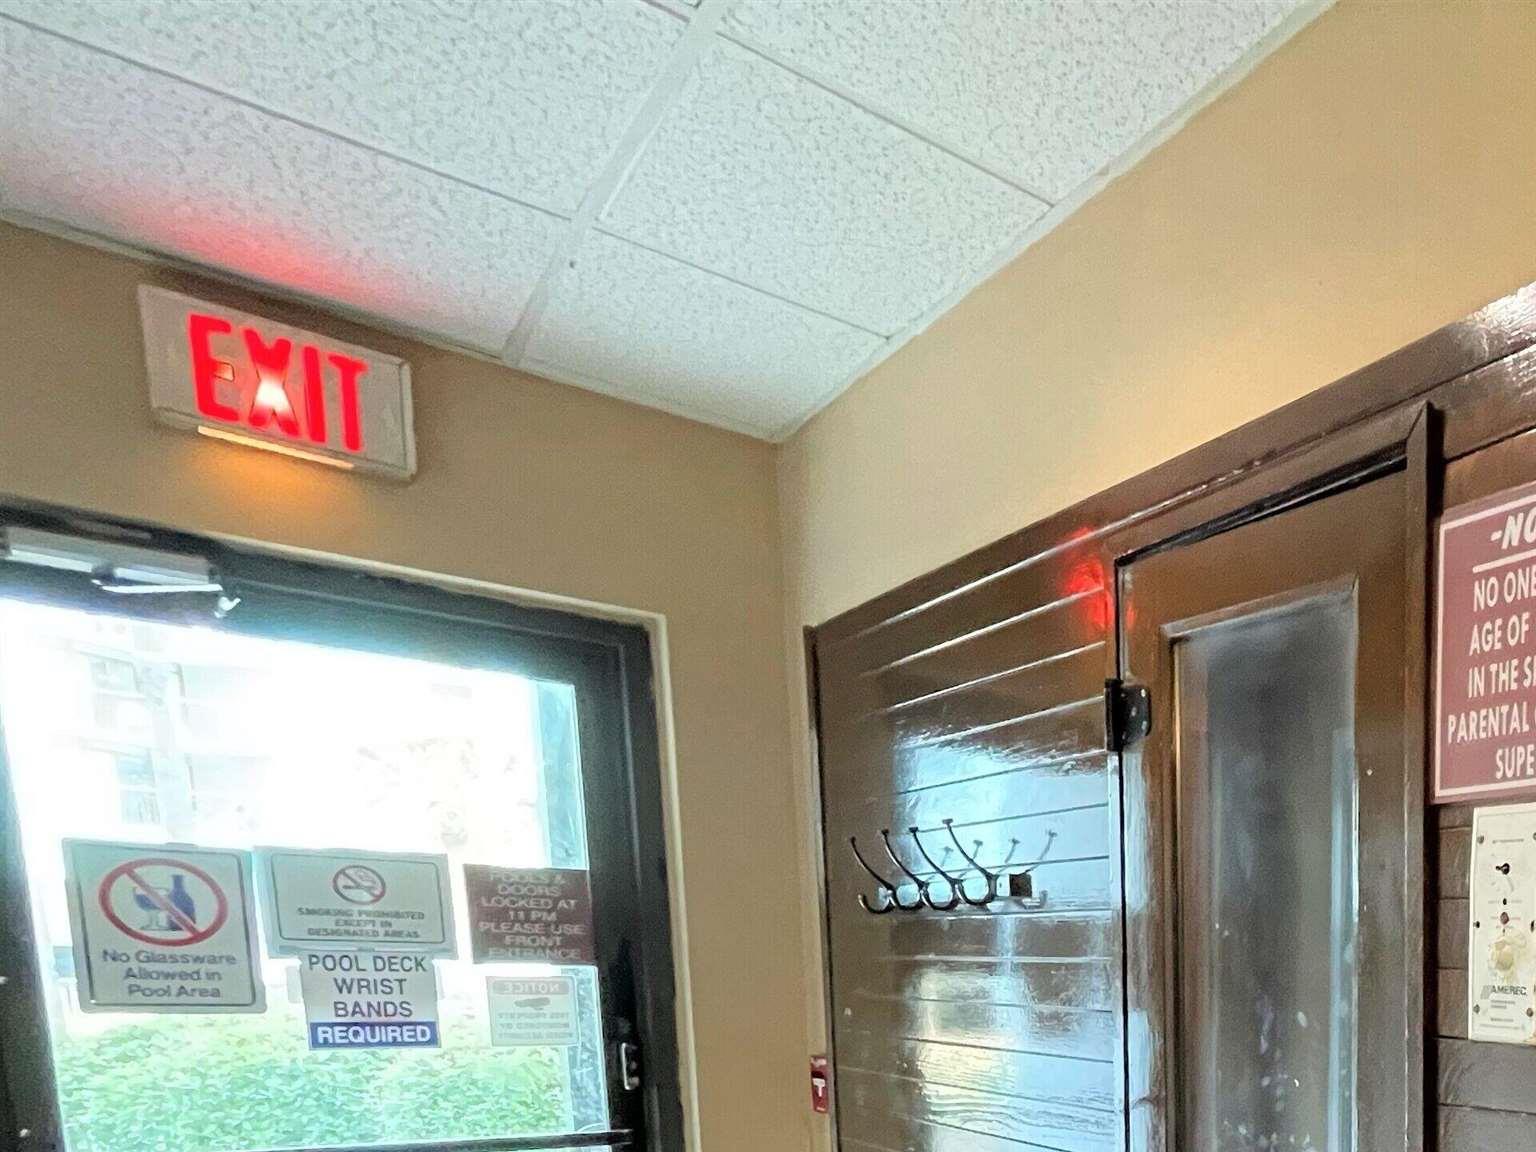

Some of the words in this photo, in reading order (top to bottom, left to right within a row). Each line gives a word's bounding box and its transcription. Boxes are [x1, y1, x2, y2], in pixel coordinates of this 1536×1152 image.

[189, 313, 368, 453] EXIT
[1473, 579, 1499, 612] NO
[1469, 620, 1502, 656] AGE
[1507, 612, 1531, 646] OF
[1468, 665, 1485, 699] IN
[1490, 659, 1518, 694] THE
[1448, 704, 1530, 745] PARENTAL
[497, 884, 561, 897] DOORS
[479, 896, 554, 909] LOCKED
[557, 899, 578, 910] AT
[297, 907, 354, 917] SMOKING
[357, 909, 425, 920] PROHIBITED
[509, 910, 525, 921] 11
[530, 911, 558, 921] PM
[335, 919, 376, 928] EXCEPT
[479, 921, 546, 934] PLEASE
[551, 923, 587, 935] USE
[307, 927, 380, 938] DESIGNATED
[383, 930, 420, 939] AREAS
[505, 935, 562, 947] FRONT
[102, 949, 130, 963] No
[135, 950, 237, 965] Glassware
[488, 947, 582, 960] ENTRANCE
[308, 954, 367, 972] POOL
[372, 955, 427, 973] DECK
[124, 966, 201, 981] Allowed
[205, 969, 222, 981] in
[128, 983, 172, 998] Pool
[175, 984, 221, 998] Area
[333, 978, 407, 995] WRIST
[333, 1000, 414, 1018] BANDS
[316, 1025, 432, 1044] REQUIRED
